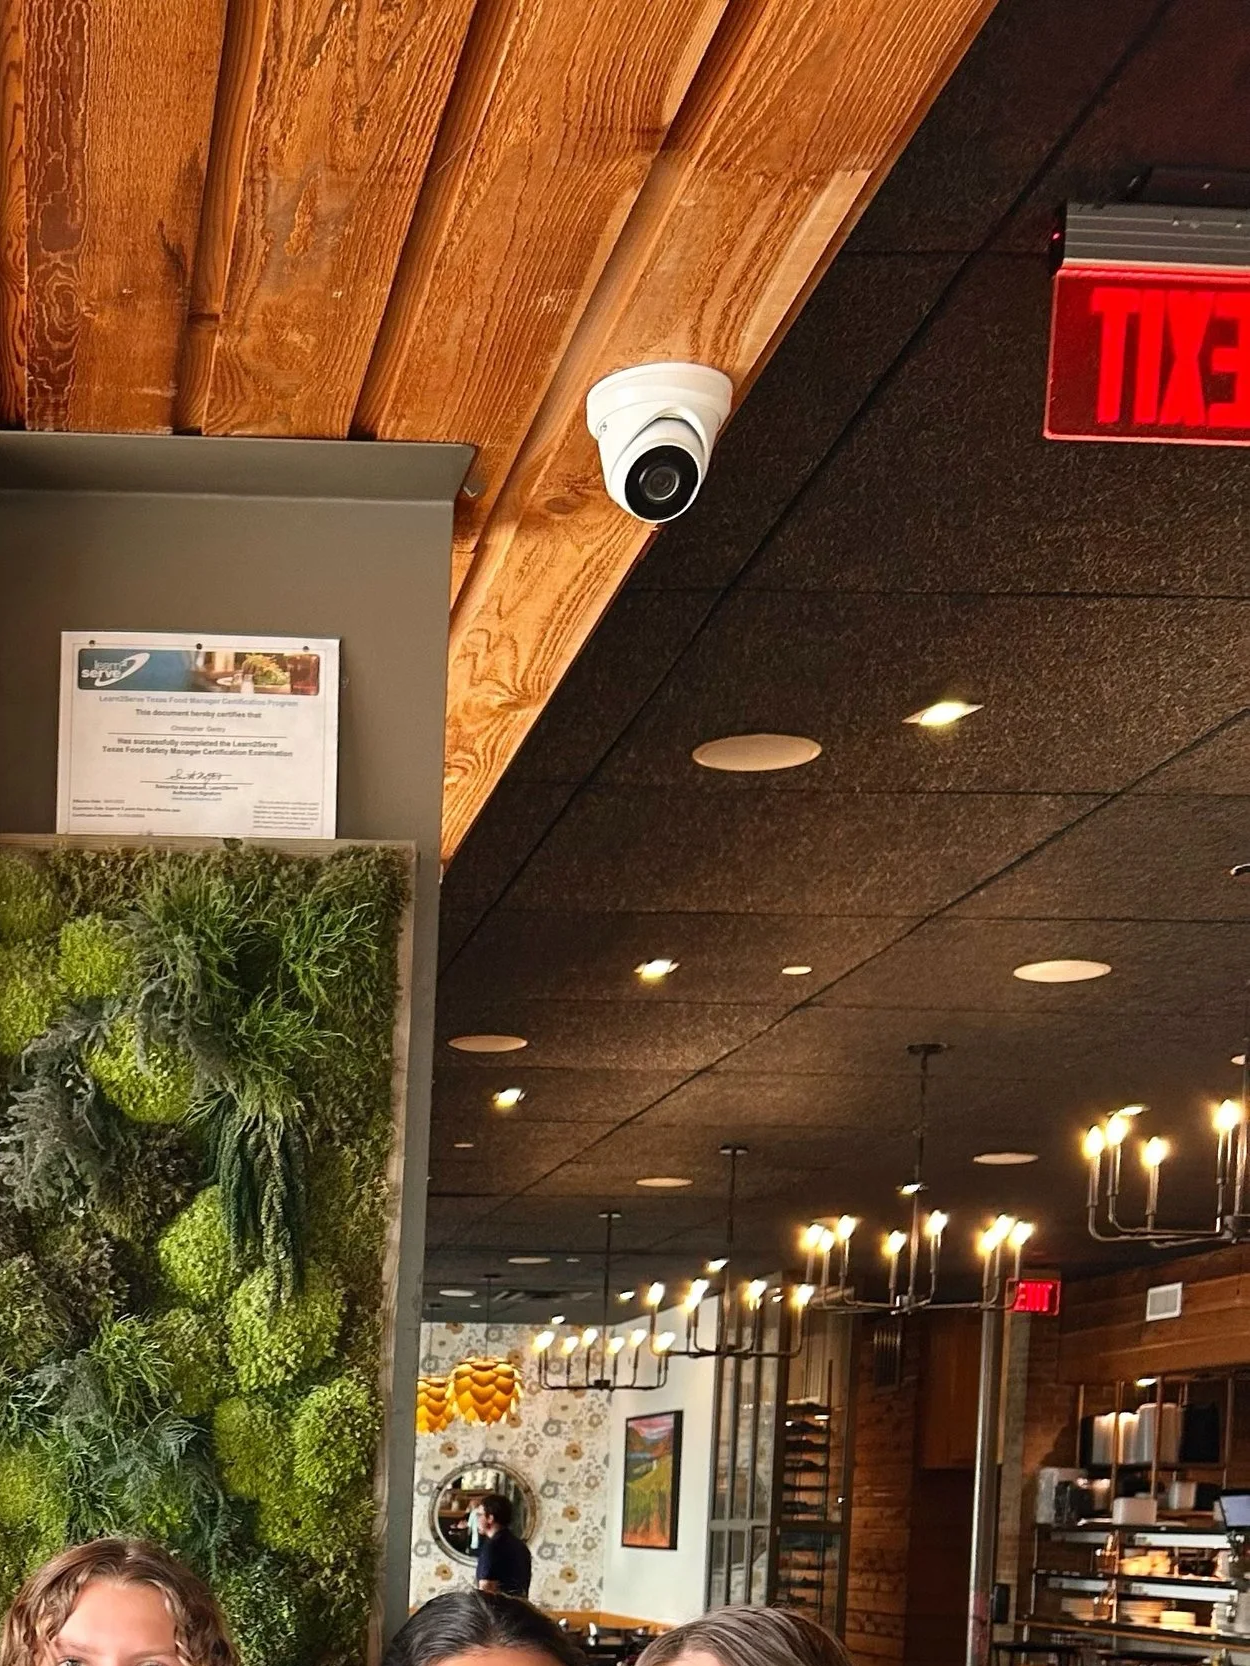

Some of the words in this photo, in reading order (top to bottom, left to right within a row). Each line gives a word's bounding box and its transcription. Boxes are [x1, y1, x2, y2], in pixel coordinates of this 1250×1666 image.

[81, 668, 121, 679] serve
[190, 697, 221, 706] Manager
[268, 699, 298, 707] Program
[190, 710, 215, 719] hereby
[133, 739, 178, 747] successfully
[180, 739, 218, 748] completed
[103, 746, 124, 754] Texas
[146, 747, 169, 755] Safety
[170, 748, 201, 756] Manager
[203, 749, 246, 757] Certification
[1014, 1283, 1053, 1311] EXIT
